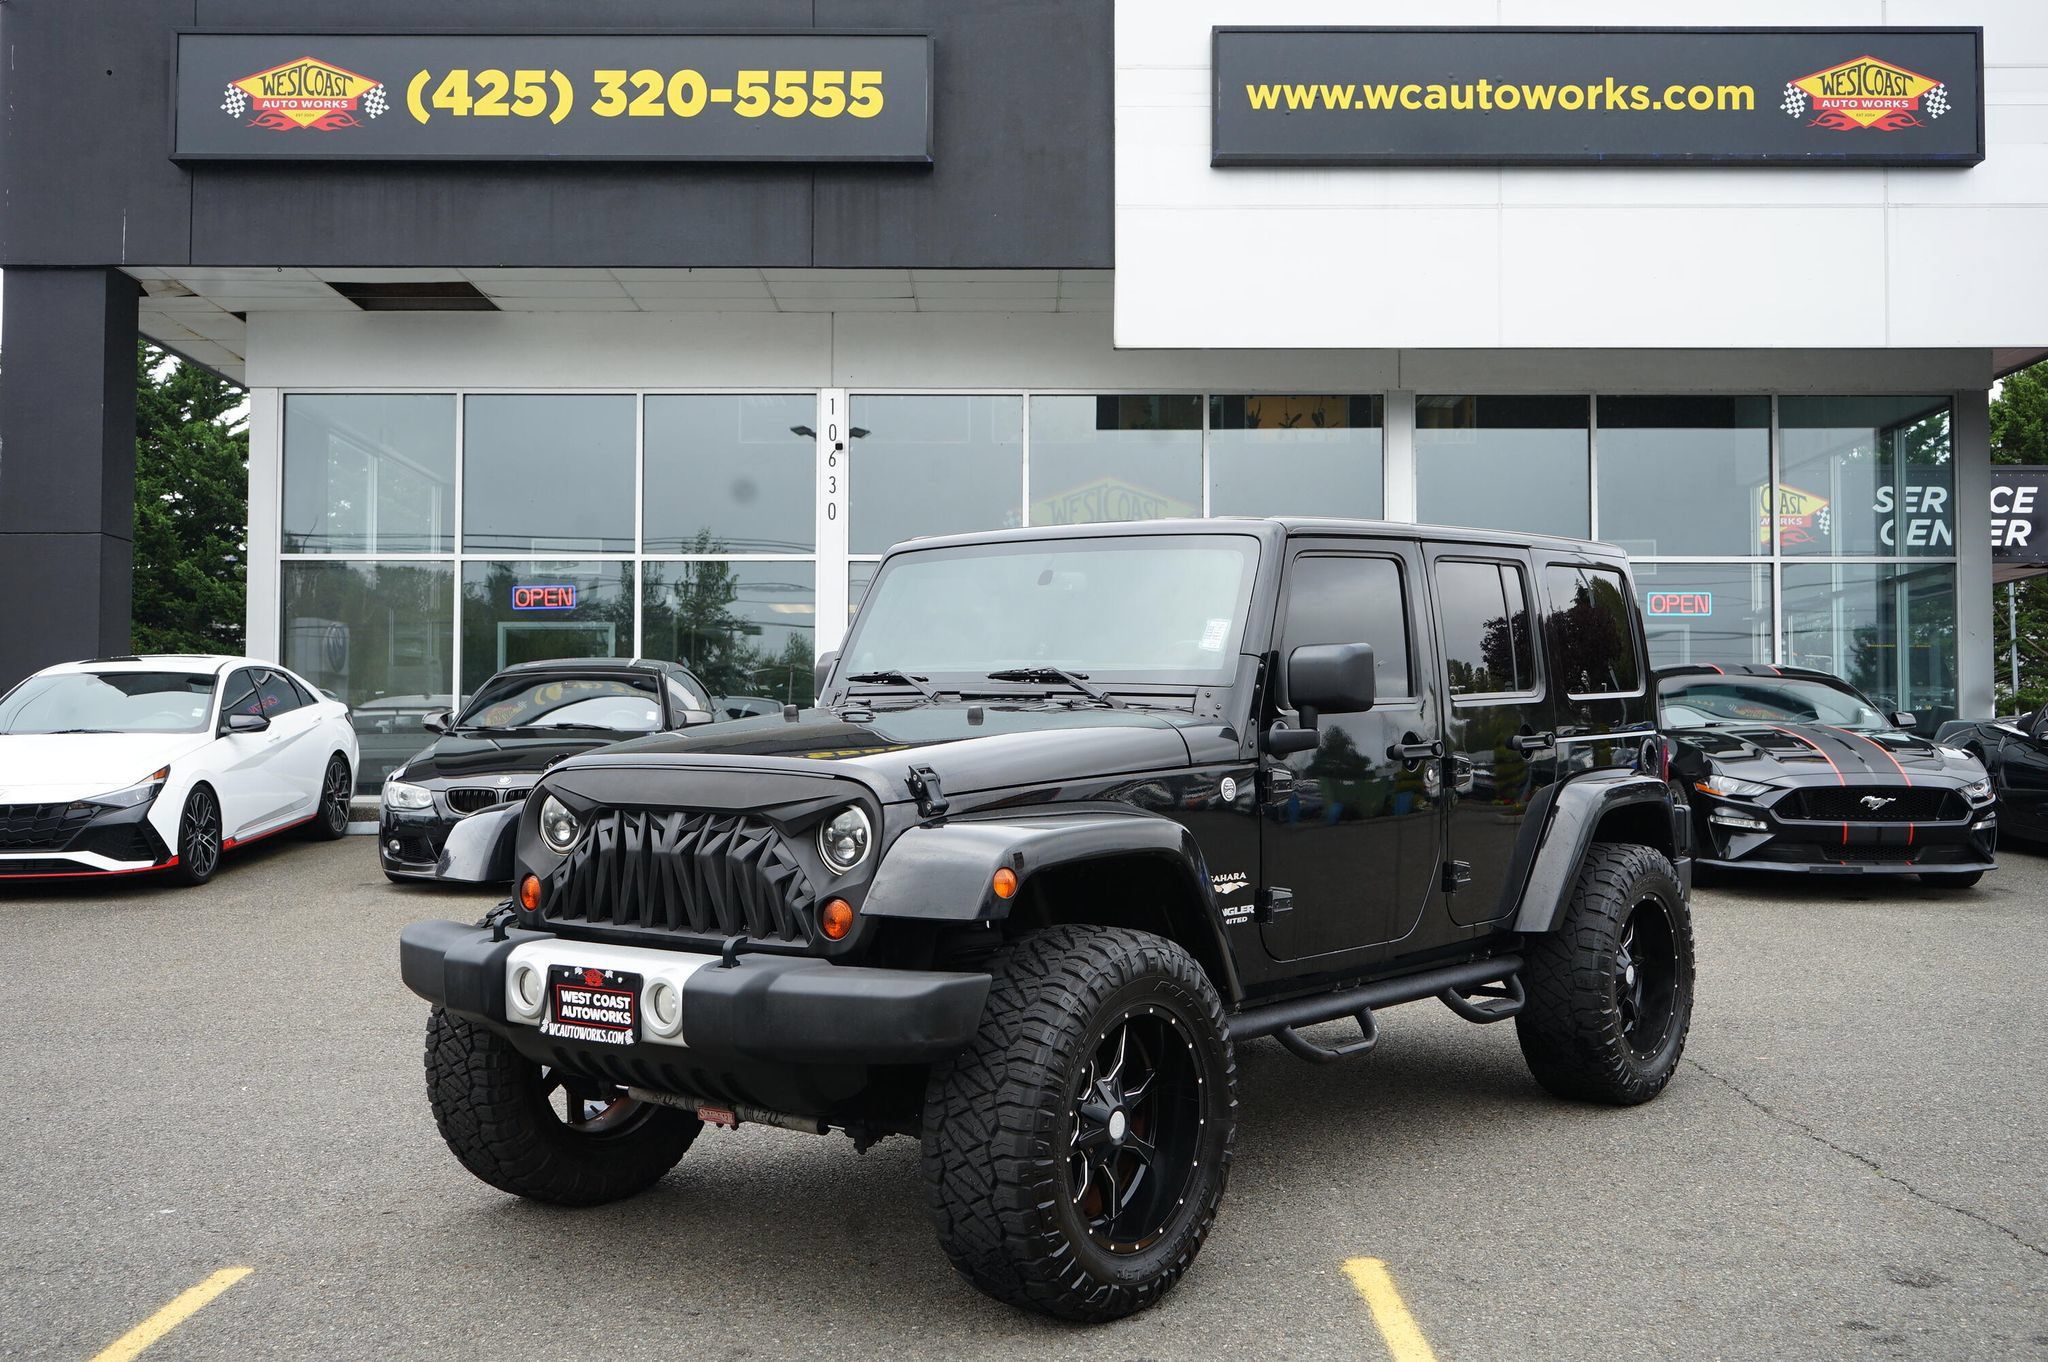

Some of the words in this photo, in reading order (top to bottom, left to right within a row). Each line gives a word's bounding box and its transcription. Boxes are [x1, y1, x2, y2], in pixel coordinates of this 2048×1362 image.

[262, 99, 298, 109] AUTO
[301, 99, 349, 109] WORKS
[406, 69, 574, 125] (425)
[590, 69, 884, 119] 320-5555
[1246, 77, 1755, 111] www.wcautoworks.com
[1822, 99, 1859, 109] AUTO
[1861, 99, 1909, 109] WORKS
[828, 398, 838, 521] 10630
[1872, 486, 2039, 514] SERCE
[1880, 519, 2032, 547] CENER
[515, 588, 572, 607] OPEN
[1651, 594, 1709, 613] OPEN
[561, 990, 592, 1005] WEST
[593, 994, 631, 1010] COAST
[561, 1005, 632, 1025] AUTOWORKS
[549, 1022, 625, 1044] WCAUTOWORKS.COM
